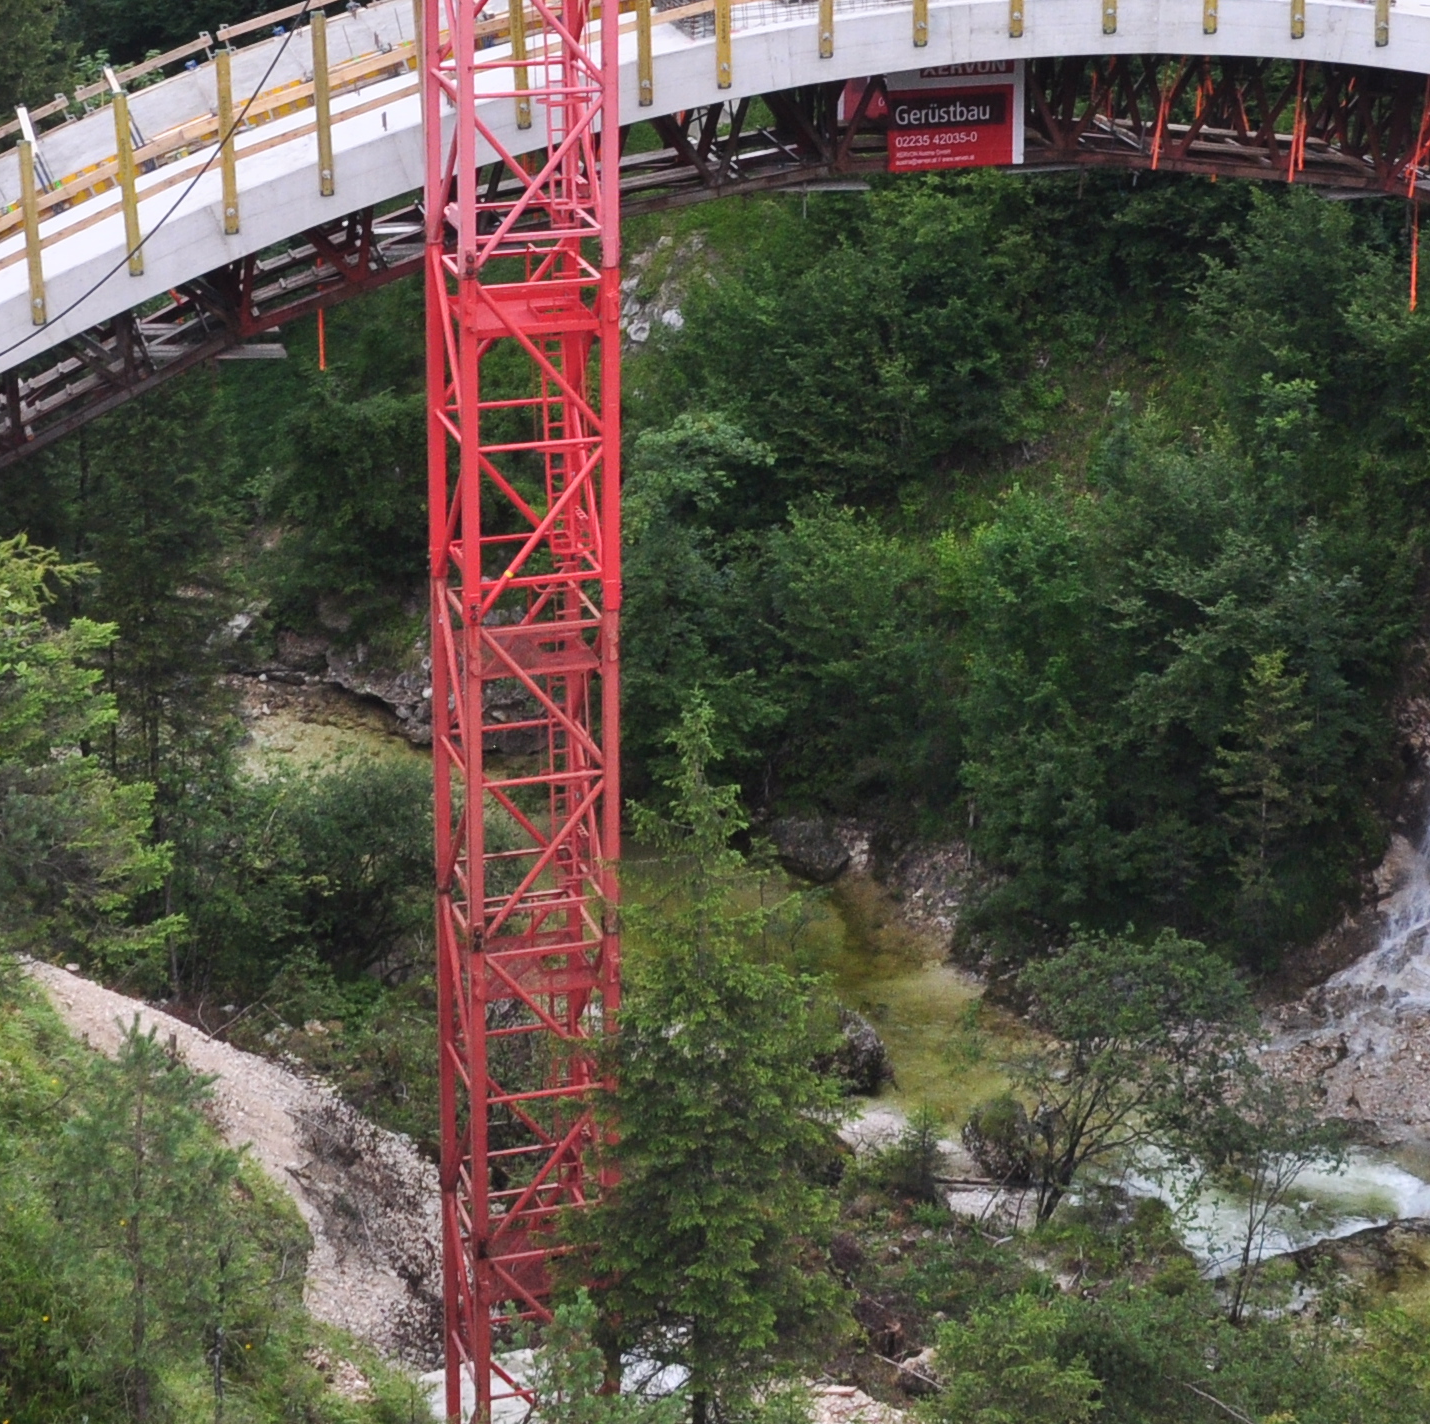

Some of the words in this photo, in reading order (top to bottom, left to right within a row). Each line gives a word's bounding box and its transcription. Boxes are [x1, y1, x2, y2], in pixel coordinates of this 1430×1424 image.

[895, 101, 990, 125] Gerüstbau
[895, 135, 930, 147] 02235
[932, 131, 977, 145] 42035-0
